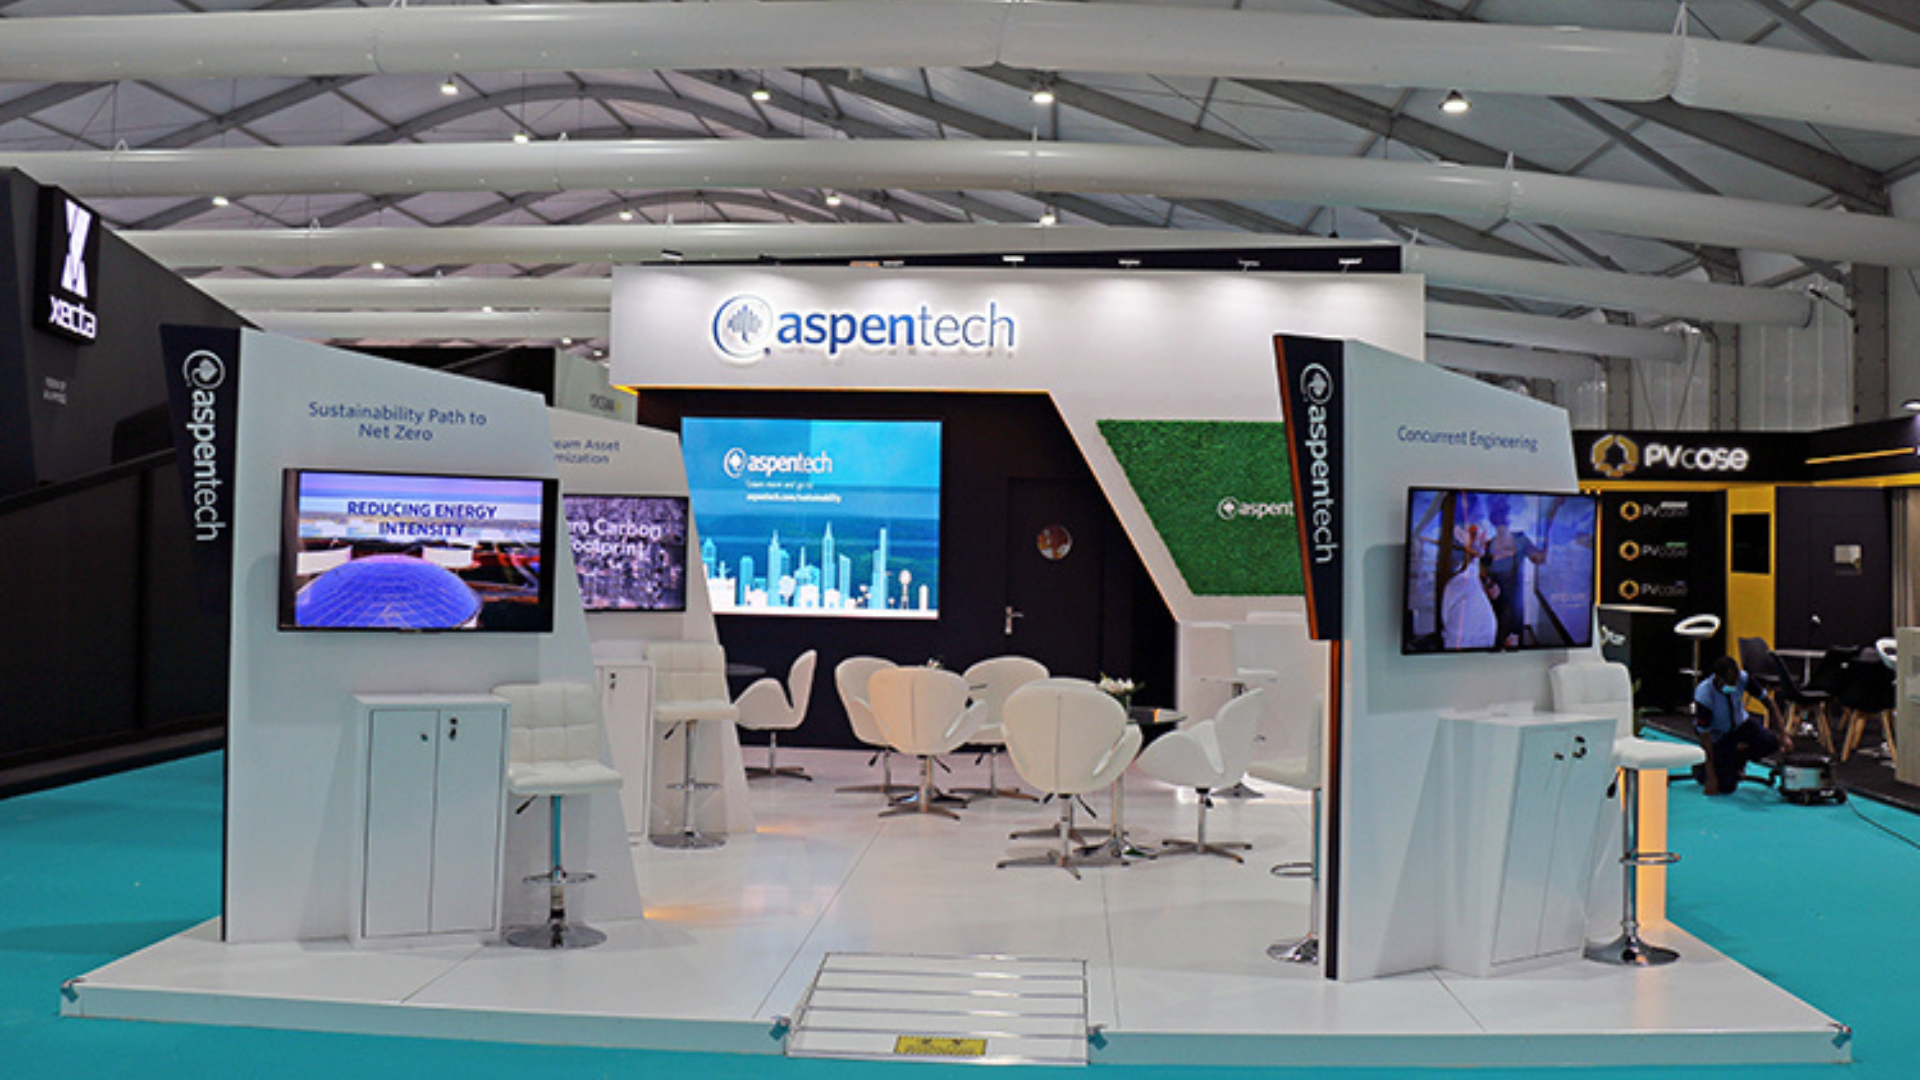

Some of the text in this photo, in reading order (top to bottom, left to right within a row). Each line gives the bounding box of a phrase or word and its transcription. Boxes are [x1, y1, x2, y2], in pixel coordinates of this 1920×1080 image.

[49, 295, 97, 339] xecta
[777, 301, 1016, 354] aspentech
[308, 400, 488, 427] Sustainability Path to
[357, 423, 434, 442] Net Zero
[583, 439, 621, 452] Asset
[1396, 424, 1539, 454] Concurrent Engineering
[186, 389, 227, 542] aspentech
[746, 450, 833, 477] aspentech
[1304, 403, 1340, 564] aspentech
[347, 500, 497, 521] REDUCING ENERGY
[1238, 500, 1296, 520] aspent
[378, 522, 465, 537] INTENSITY
[570, 538, 646, 560] ootprint
